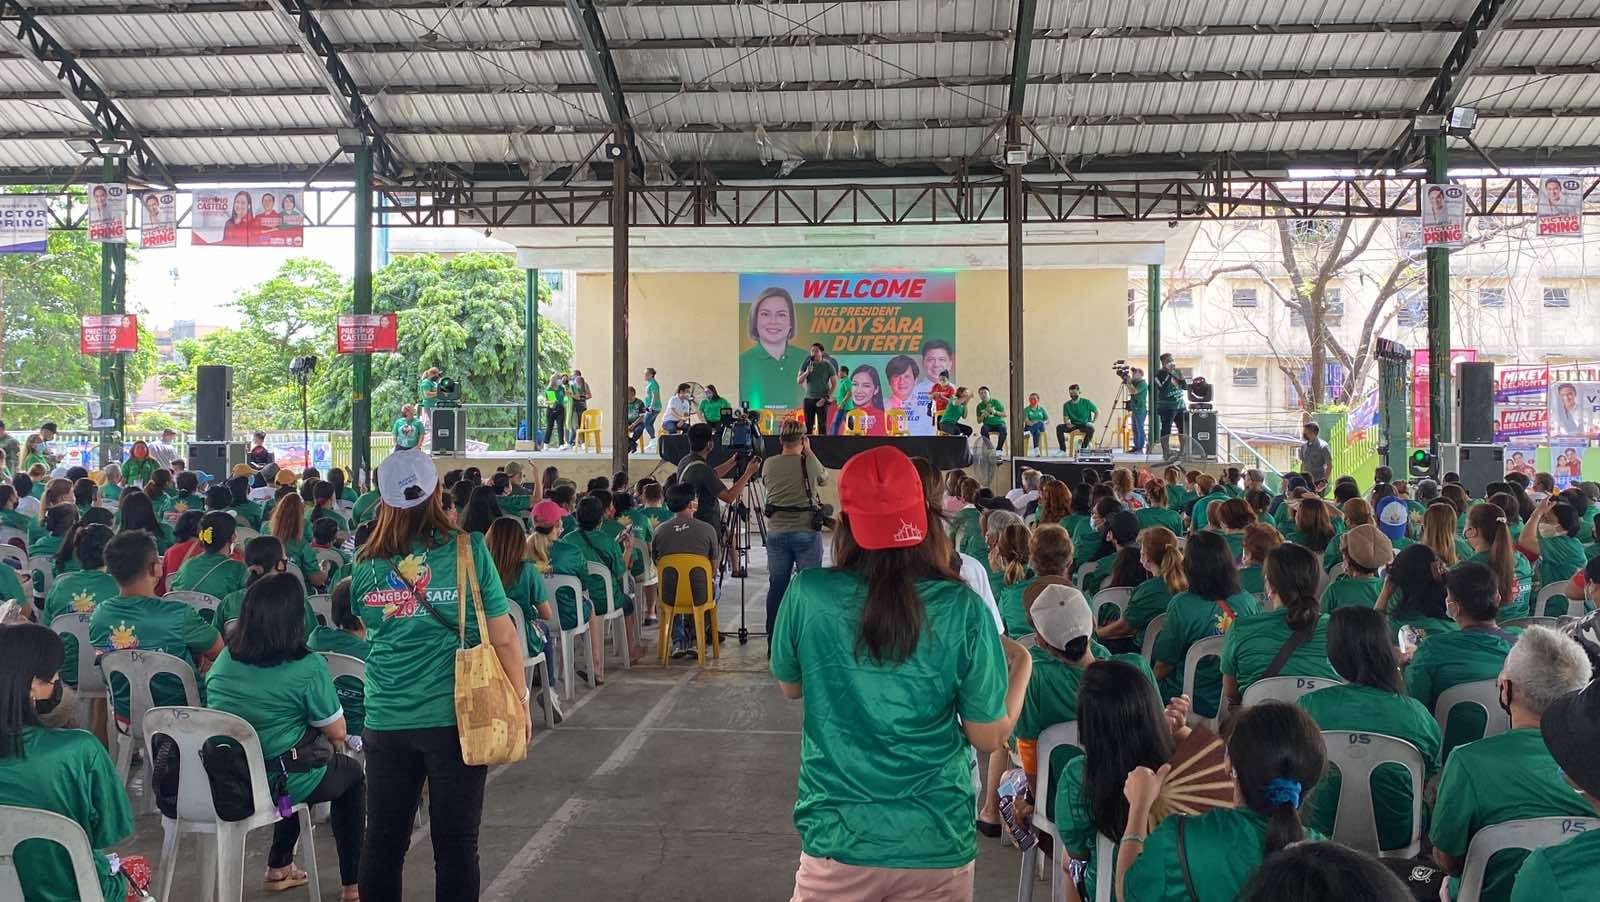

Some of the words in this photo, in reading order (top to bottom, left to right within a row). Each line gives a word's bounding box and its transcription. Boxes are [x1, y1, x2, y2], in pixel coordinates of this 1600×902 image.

[91, 225, 123, 240] PRING
[1541, 221, 1580, 235] PRING
[143, 232, 175, 246] PRING
[1424, 231, 1462, 245] PRING
[803, 279, 927, 298] WELCOME
[814, 307, 838, 316] VICE
[840, 307, 902, 316] PRESIDENT
[810, 317, 870, 333] INDAY
[870, 317, 923, 333] SARA
[832, 335, 922, 352] DUTERTE
[1503, 369, 1547, 383] MIKEY
[1504, 411, 1547, 423] MIKEY
[1503, 420, 1547, 430] BELMONTE
[1297, 679, 1315, 688] DS
[1350, 733, 1371, 744] DS
